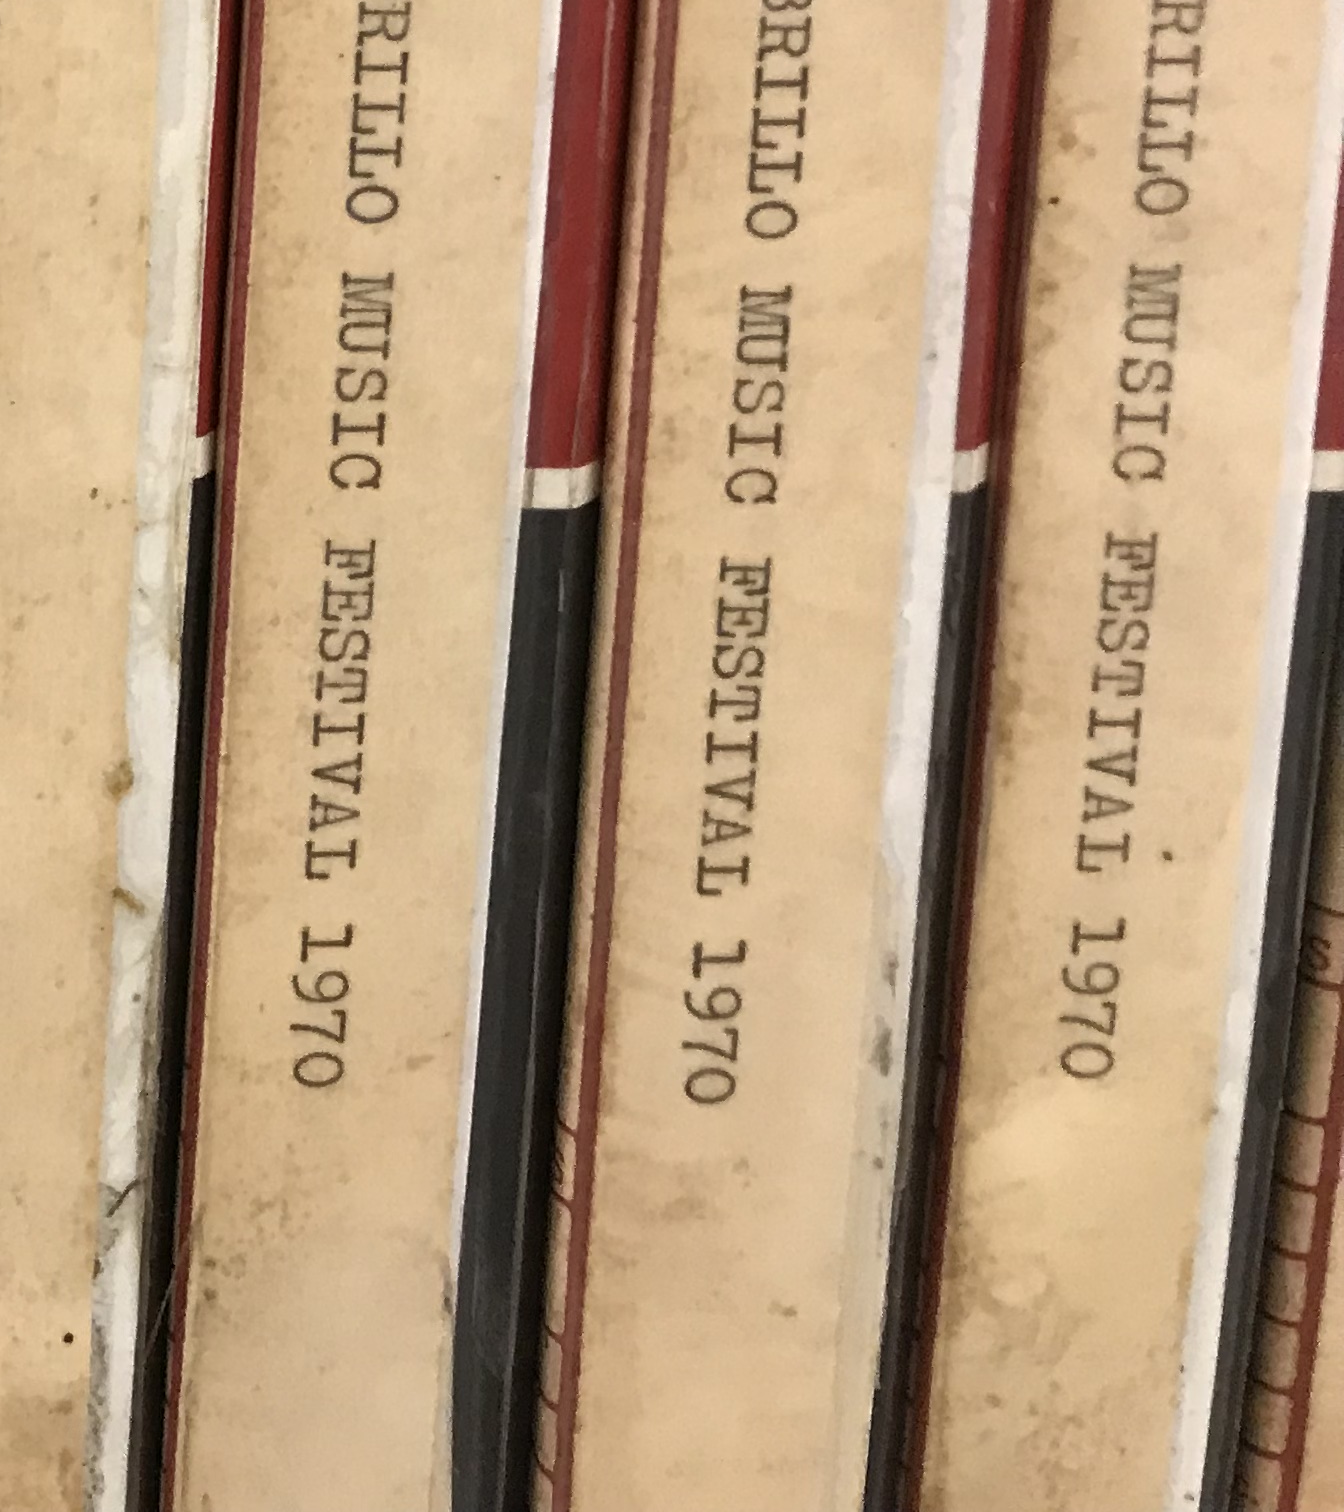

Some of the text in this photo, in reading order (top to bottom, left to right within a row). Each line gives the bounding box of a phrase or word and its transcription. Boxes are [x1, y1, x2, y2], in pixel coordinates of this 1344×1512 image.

[329, 269, 396, 491] MUSIC
[723, 283, 794, 507] MUSIC
[1112, 262, 1184, 483] MUSIC
[302, 538, 377, 882] FESTIVAL
[695, 555, 774, 900] FESTIVAL
[1074, 532, 1160, 876] FESTIVAL
[289, 922, 354, 1089] 1970
[681, 939, 748, 1106] 1970
[1058, 917, 1128, 1082] 1970
